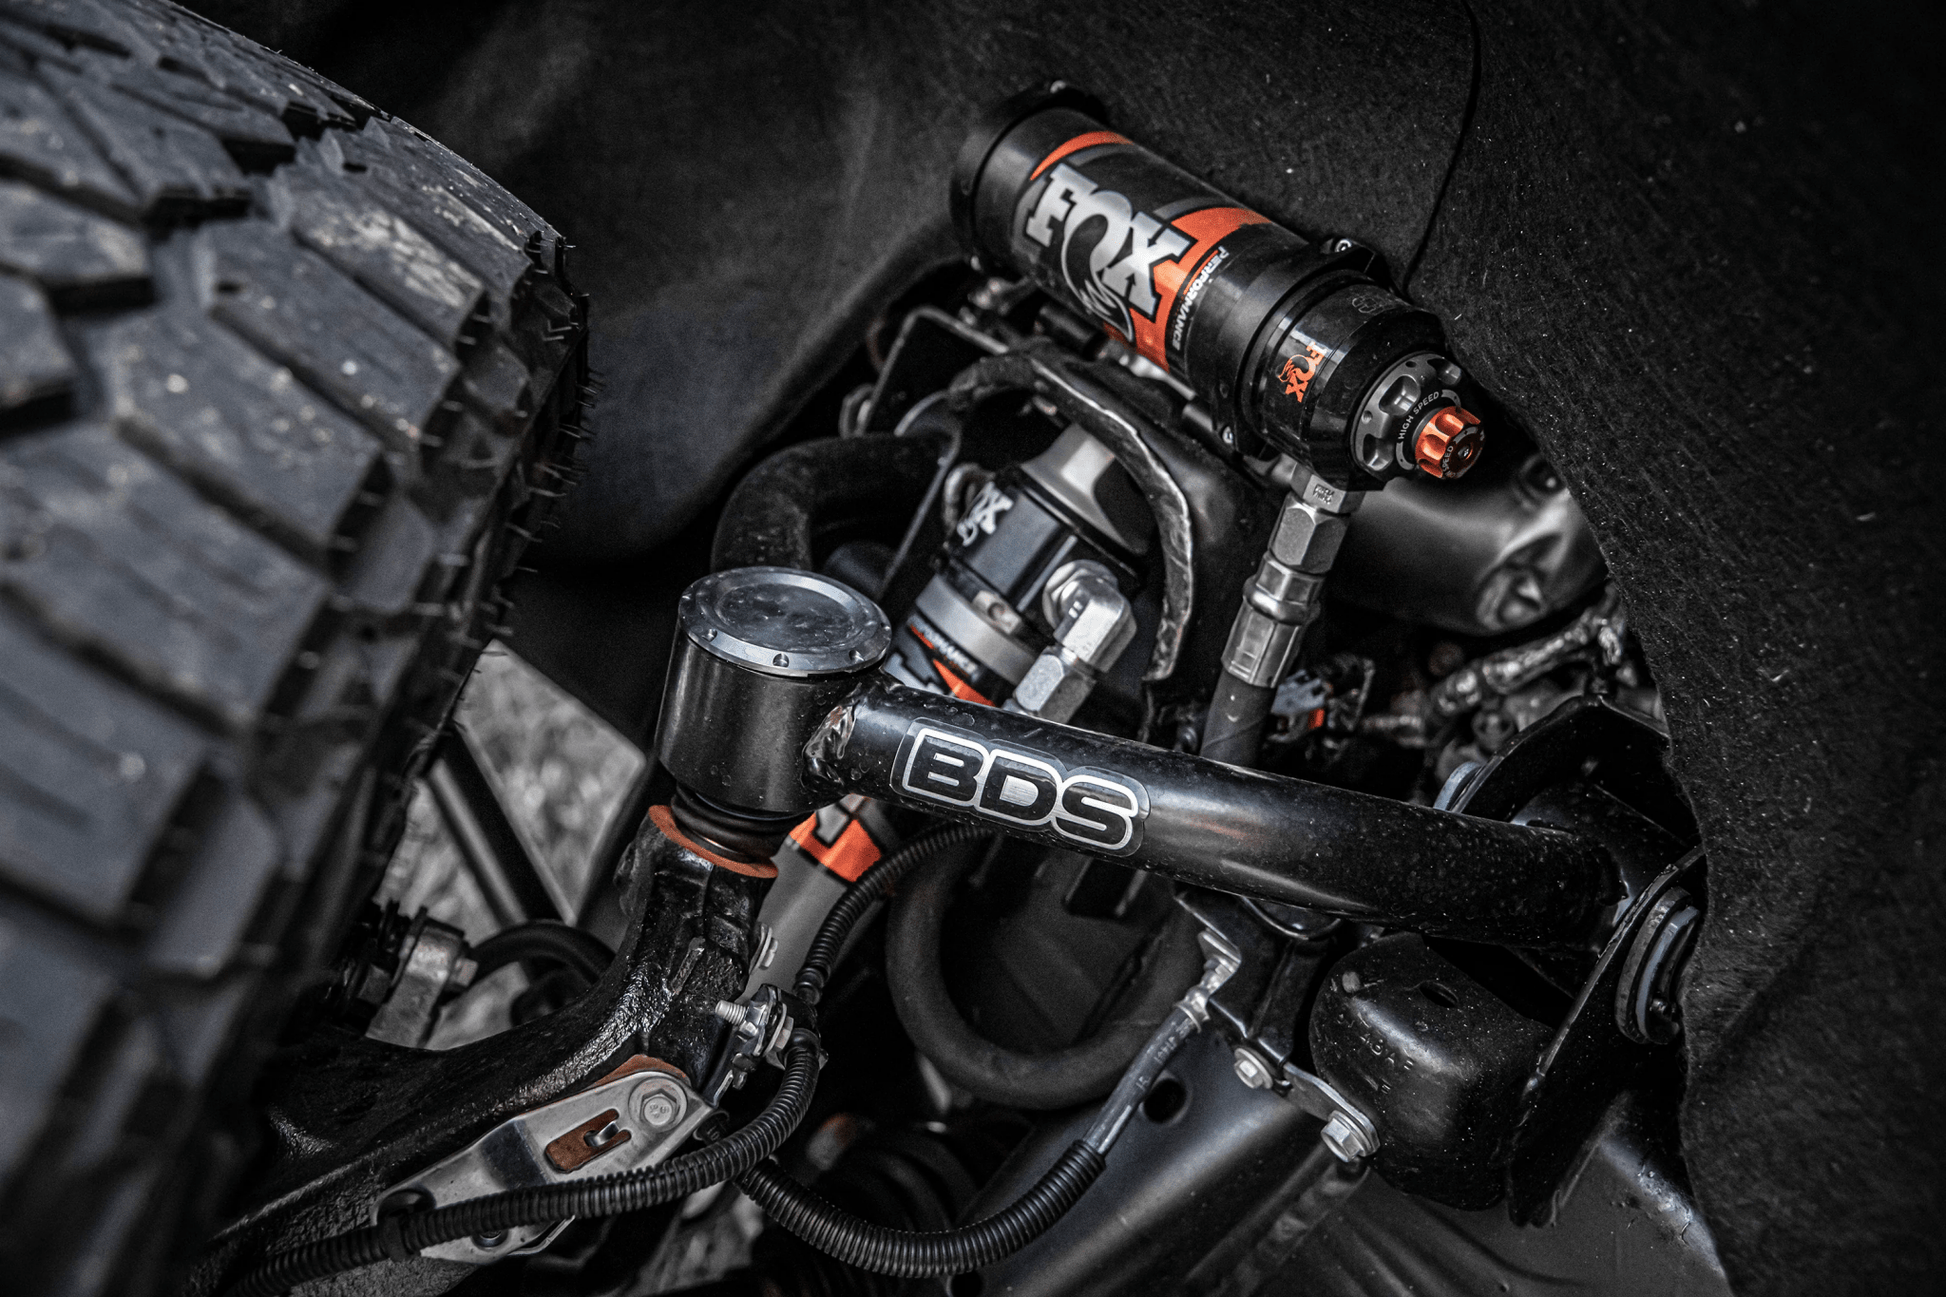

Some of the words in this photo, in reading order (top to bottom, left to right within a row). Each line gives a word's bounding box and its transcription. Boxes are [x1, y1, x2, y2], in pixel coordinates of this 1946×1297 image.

[1026, 162, 1191, 340] FOX
[1172, 246, 1230, 351] PERFORMANCE
[1279, 340, 1327, 403] FOX
[1398, 415, 1414, 440] HIGH
[1413, 391, 1440, 414] SPEED
[902, 728, 1139, 851] BDS
